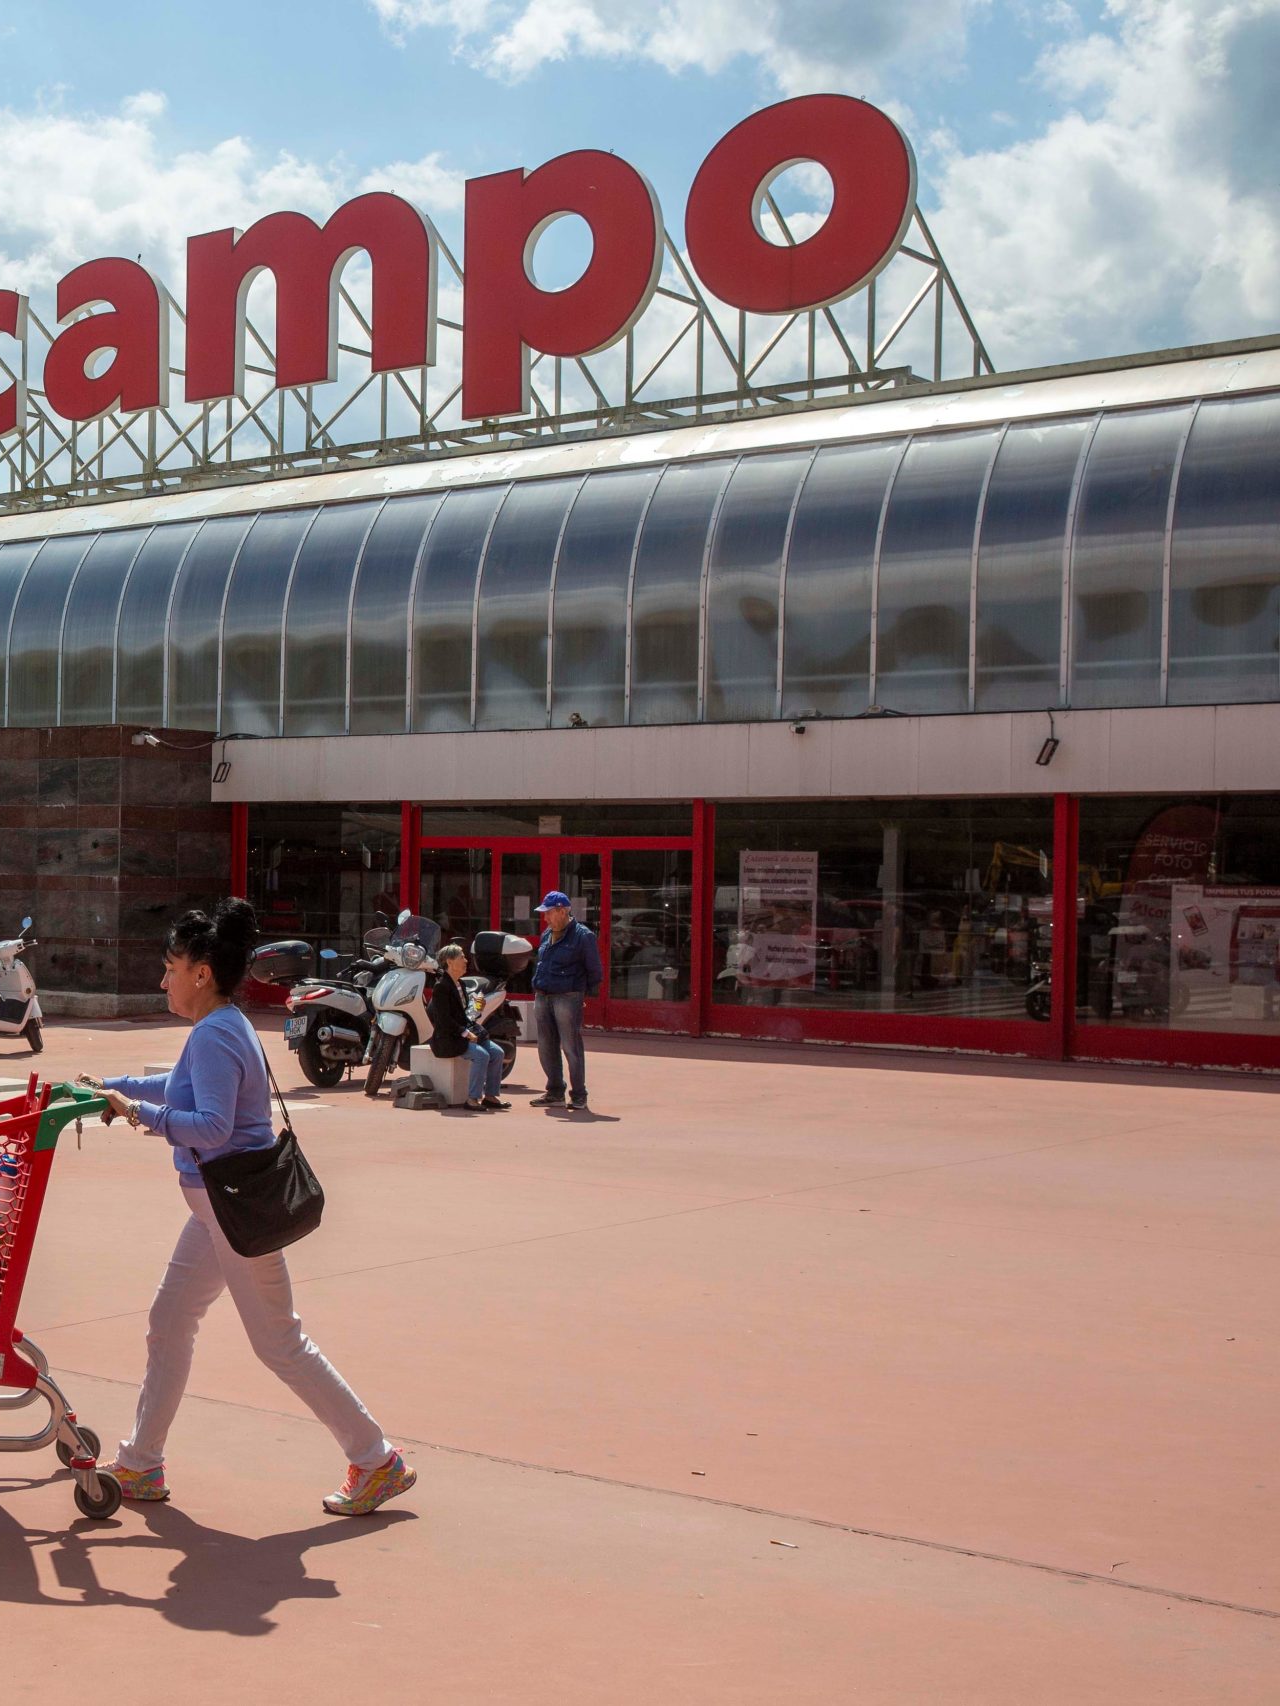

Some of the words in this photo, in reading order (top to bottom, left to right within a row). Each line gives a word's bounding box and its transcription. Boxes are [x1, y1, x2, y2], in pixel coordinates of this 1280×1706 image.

[1154, 854, 1193, 870] FOTO
[1239, 887, 1254, 896] TUS
[1132, 900, 1169, 919] Alca
